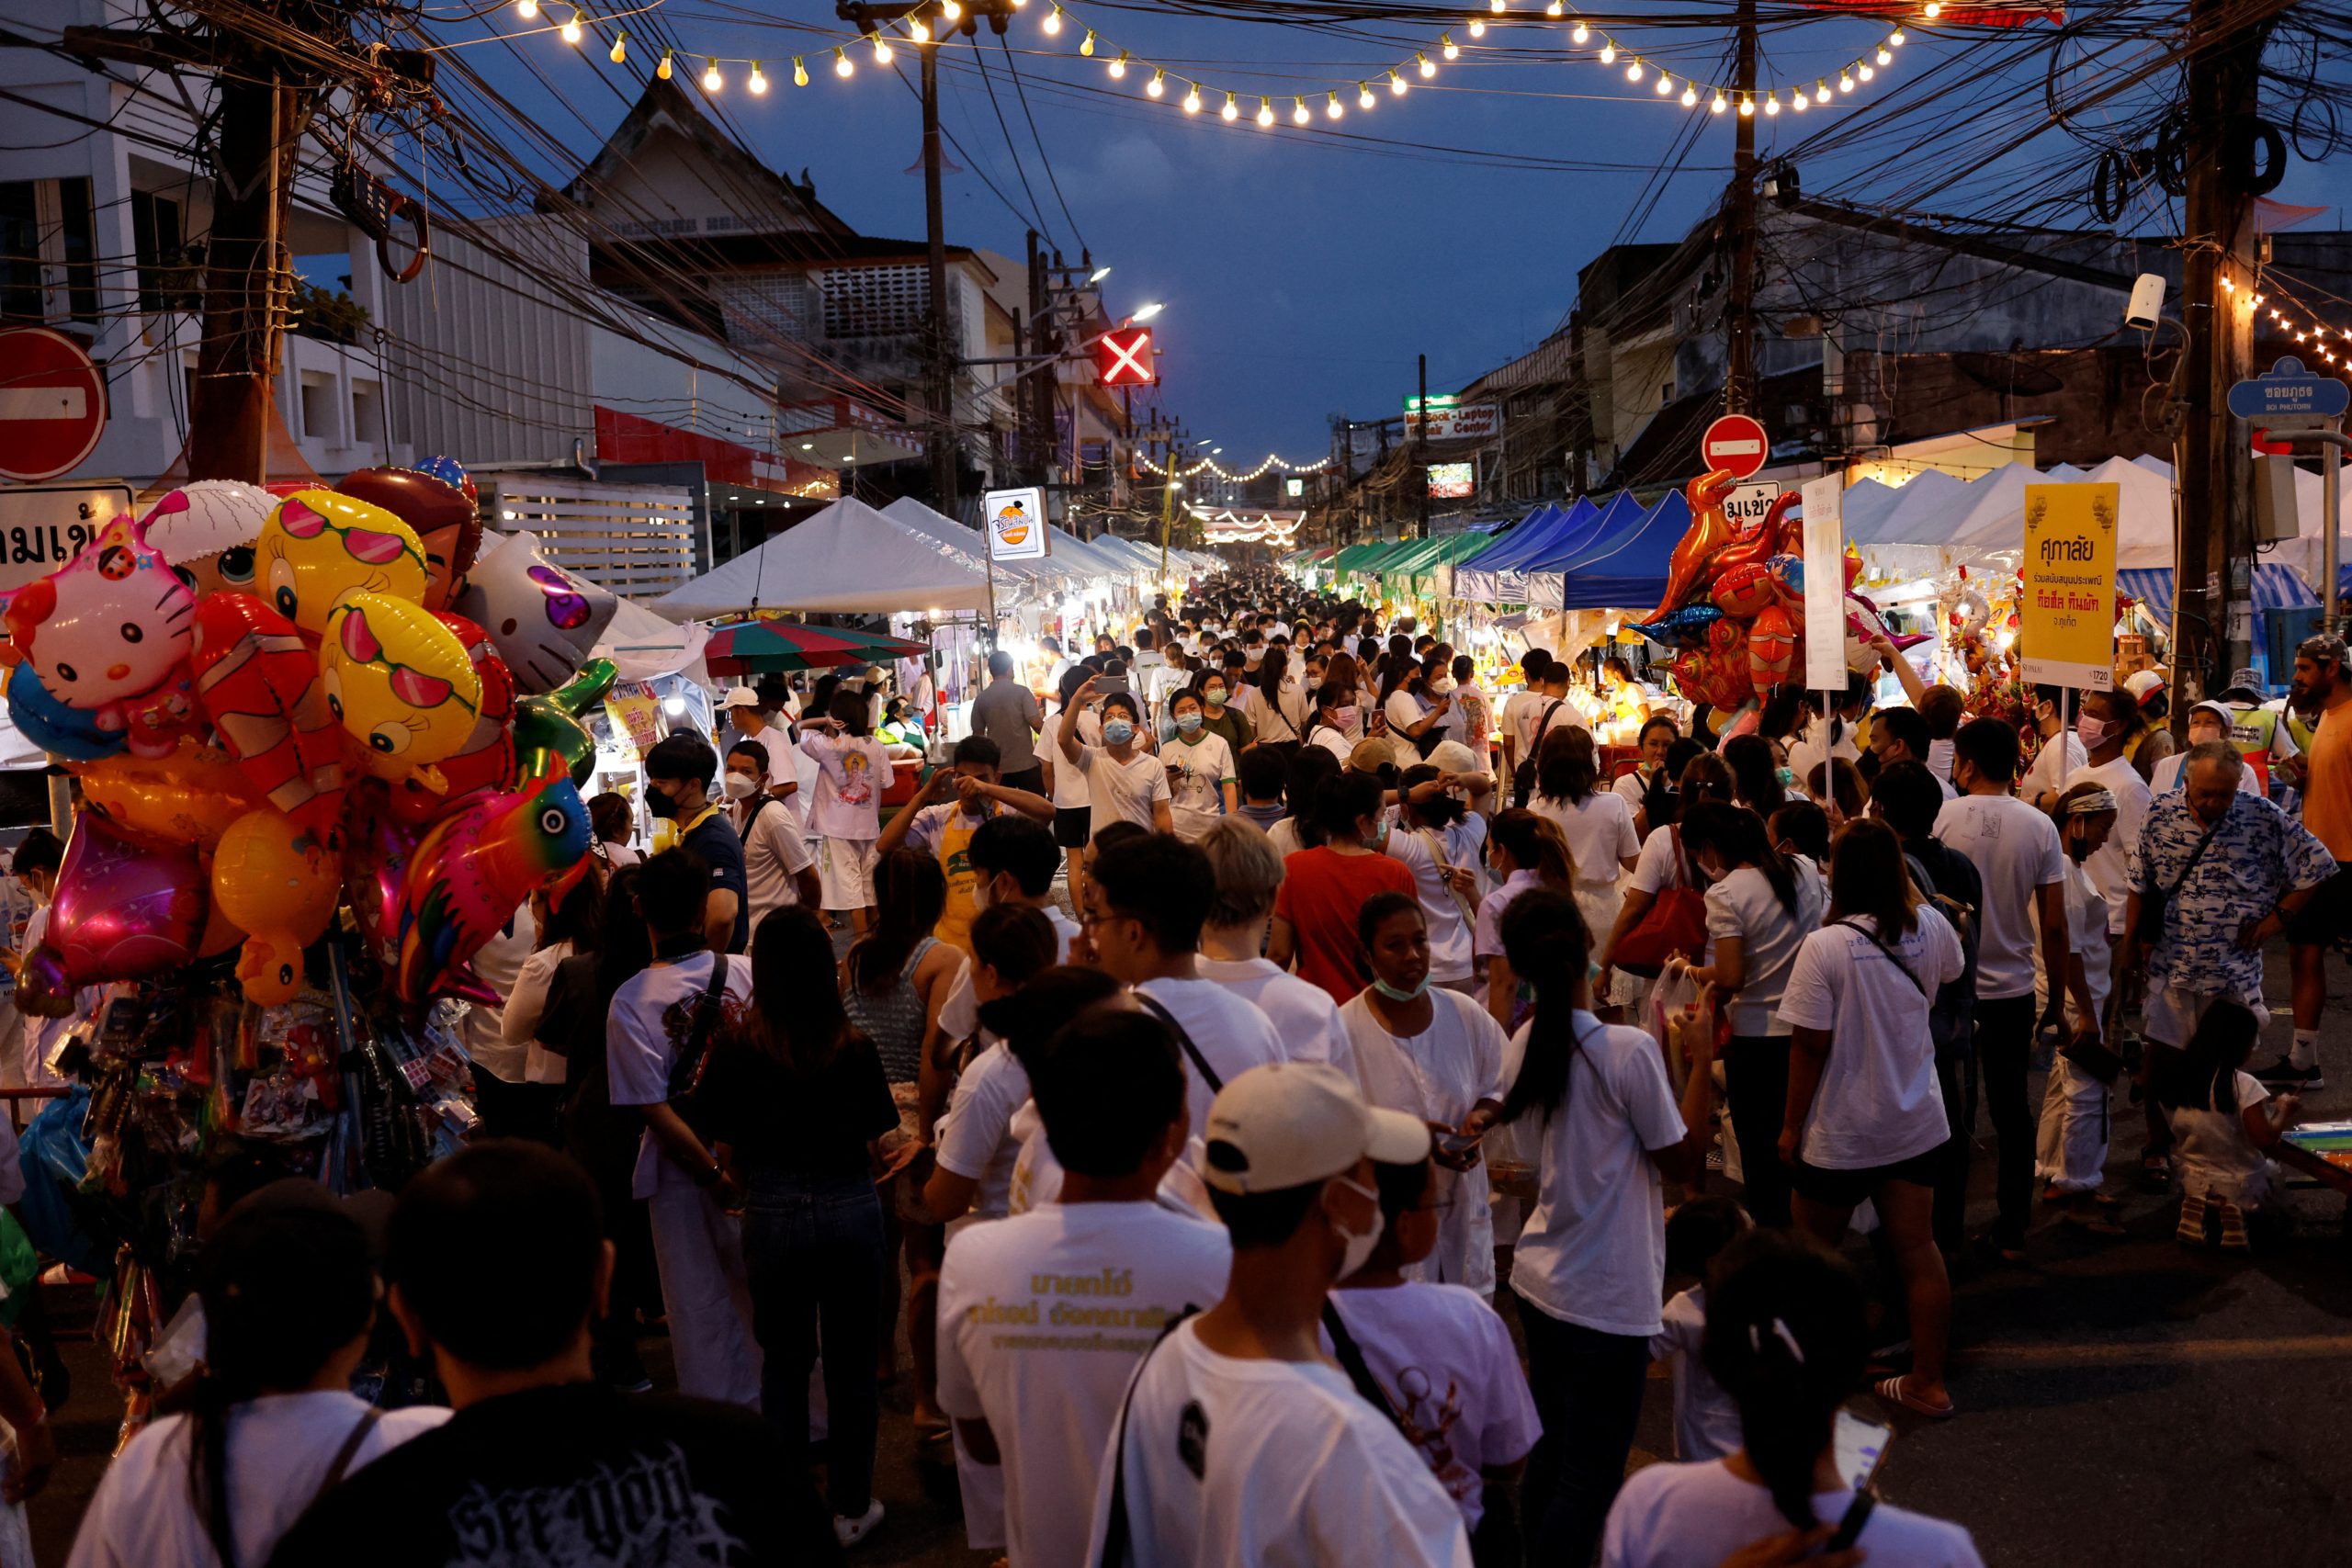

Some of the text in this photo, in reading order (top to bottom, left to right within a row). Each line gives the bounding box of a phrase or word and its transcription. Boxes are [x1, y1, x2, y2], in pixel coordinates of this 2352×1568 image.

[1458, 408, 1495, 422] Laptop
[1453, 422, 1492, 434] Center
[1724, 490, 1774, 518] มเข้า
[2041, 535, 2094, 567] ศุภาลัย
[2033, 573, 2102, 587] ร่วมสนับสนุนประเพณี
[2037, 589, 2099, 612] ถือศีล กินผัก
[2053, 615, 2076, 628] จ.ภูเก็ต
[2022, 663, 2043, 673] SUPALAI
[2093, 670, 2109, 681] 1720
